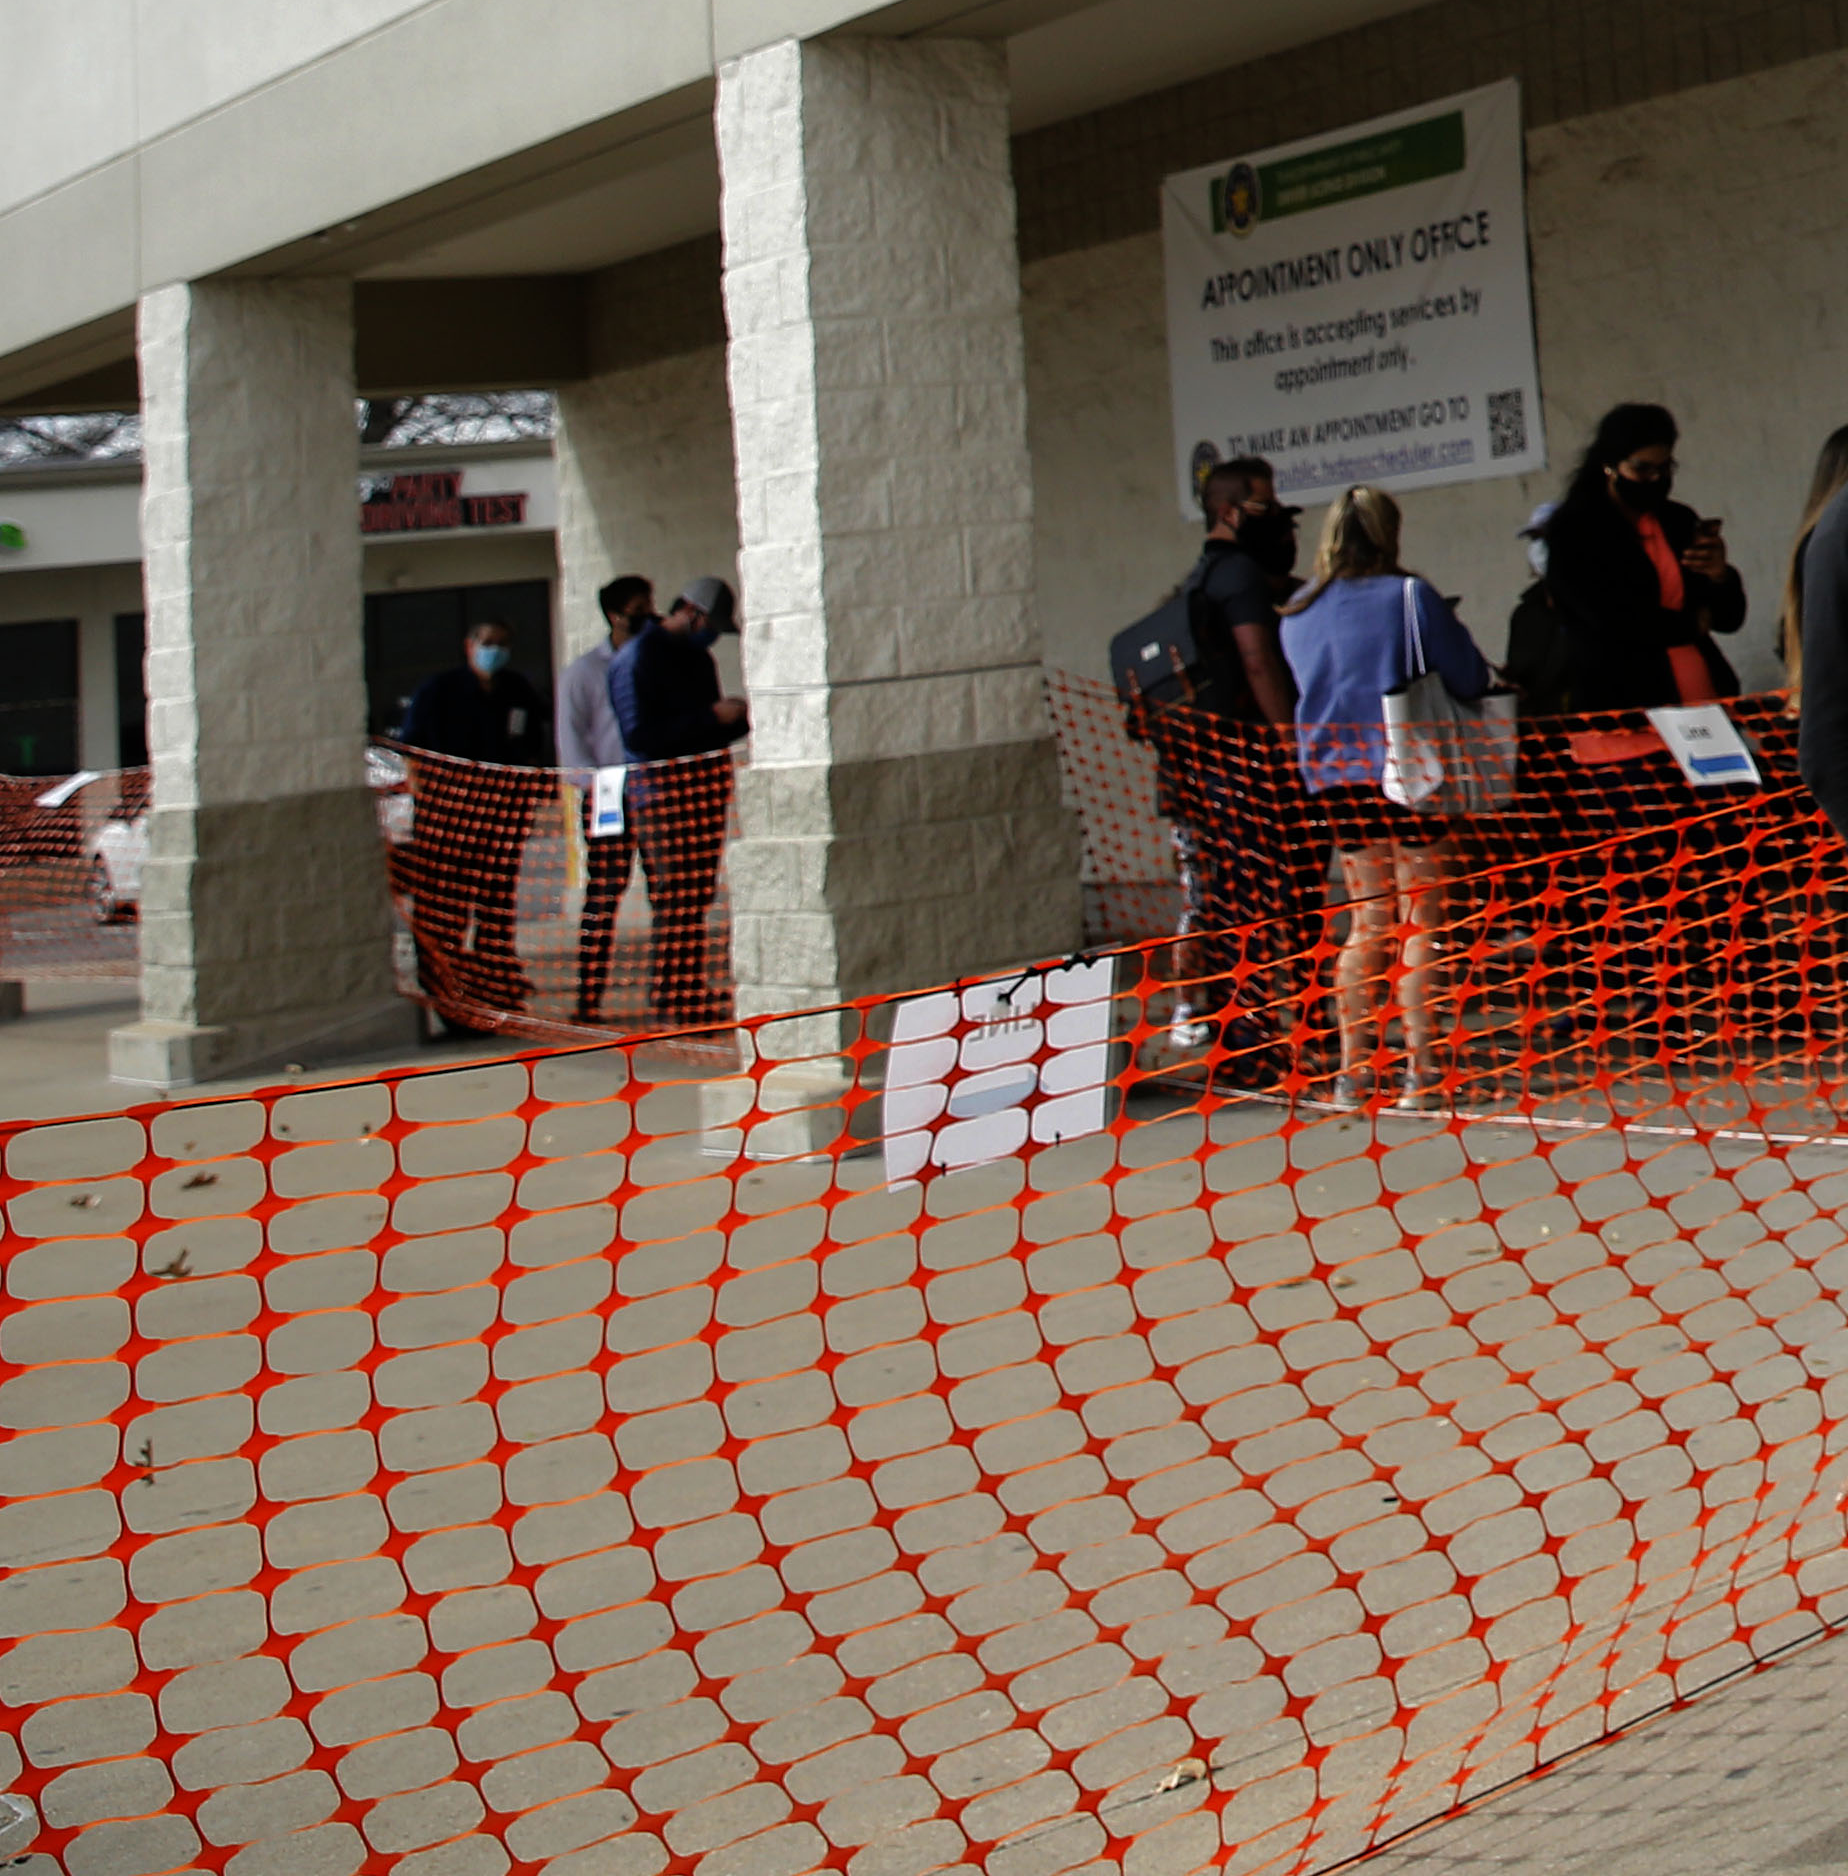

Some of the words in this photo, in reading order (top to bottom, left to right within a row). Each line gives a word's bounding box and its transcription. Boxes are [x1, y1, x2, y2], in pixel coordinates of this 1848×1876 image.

[1202, 246, 1342, 311] APPOINTMENT
[1346, 232, 1406, 277] ONLY
[1410, 210, 1491, 264] OFFICE
[1210, 336, 1240, 364] This
[1303, 308, 1387, 340] accepting
[1388, 292, 1458, 329] services
[1459, 284, 1482, 317] by
[1417, 398, 1448, 428] GO
[1448, 393, 1472, 422] TO
[466, 492, 530, 526] TEST
